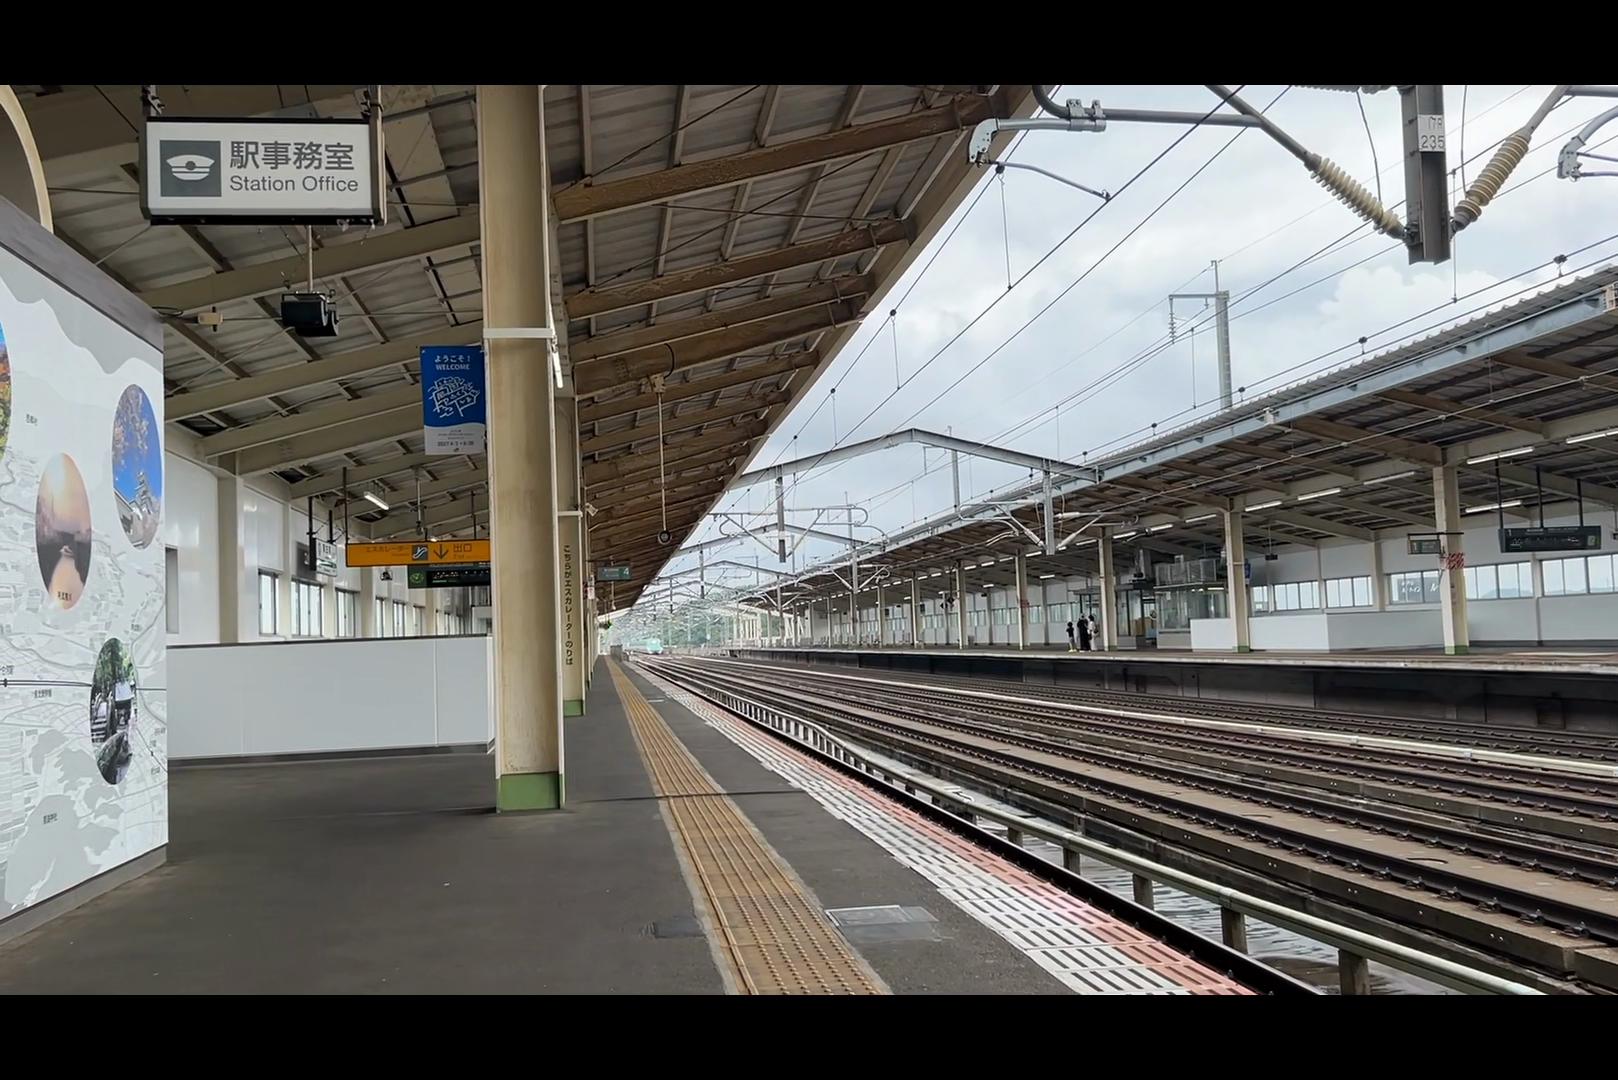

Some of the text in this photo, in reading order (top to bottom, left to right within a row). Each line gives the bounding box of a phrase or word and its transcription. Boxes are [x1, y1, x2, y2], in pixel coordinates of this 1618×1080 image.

[1421, 135, 1445, 149] 235
[229, 140, 355, 171] 駅事務室
[230, 175, 359, 192] Station Office
[453, 543, 473, 553] 出口
[563, 545, 574, 666] こちらがエスカレーターのりば
